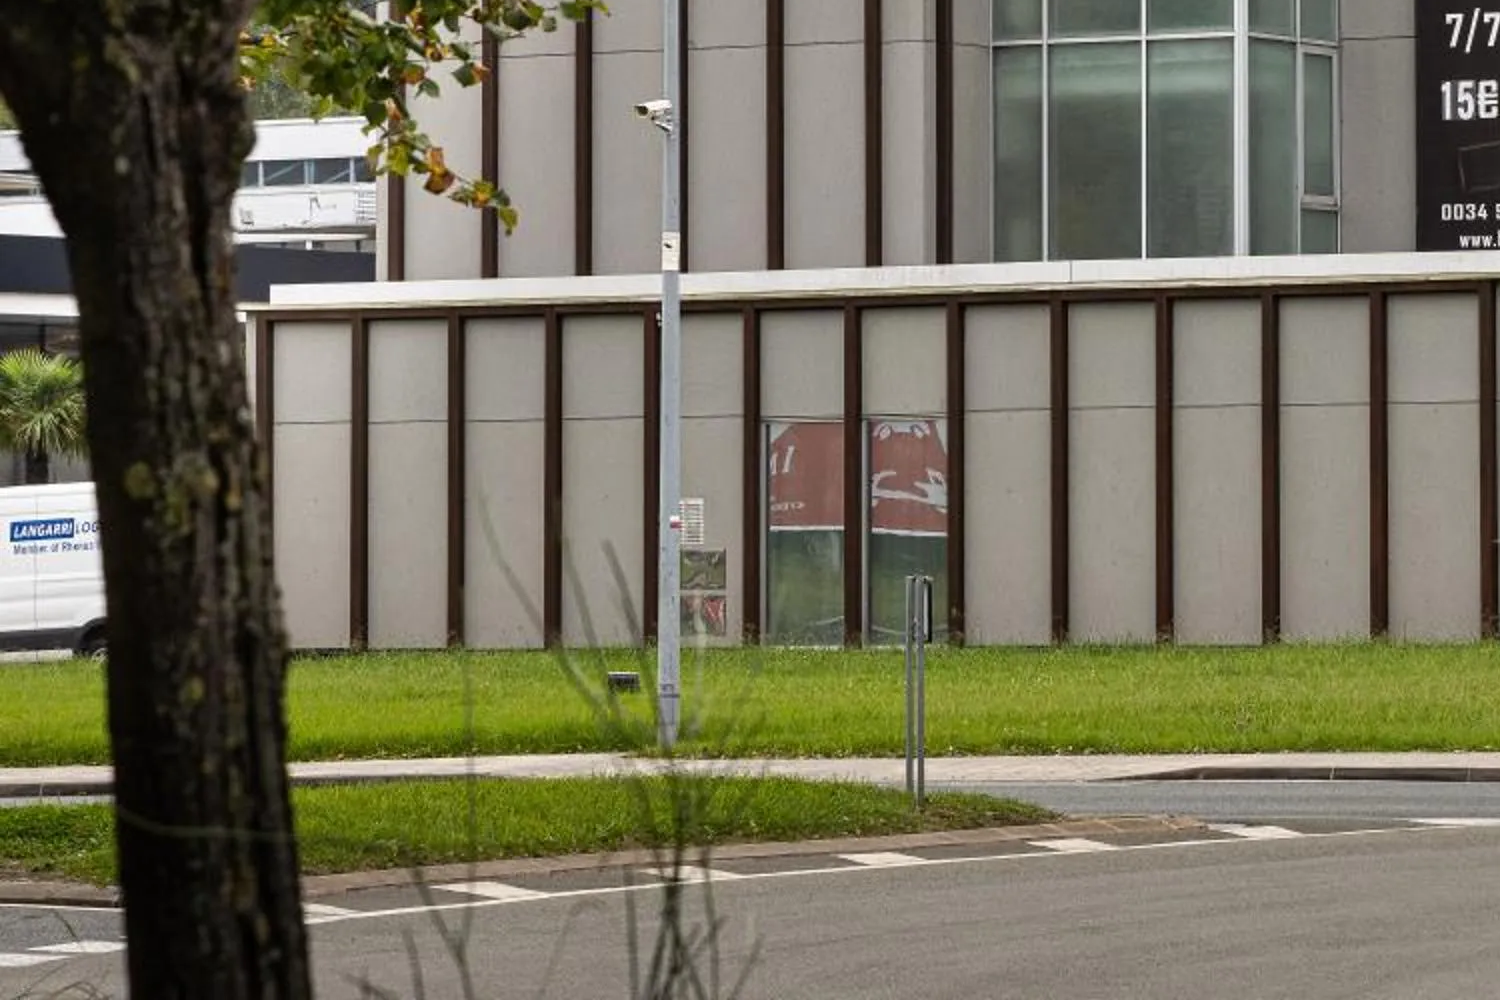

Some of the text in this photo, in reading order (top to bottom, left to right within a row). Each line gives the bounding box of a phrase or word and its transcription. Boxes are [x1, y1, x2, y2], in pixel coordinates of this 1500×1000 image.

[1441, 80, 1499, 121] 15€
[1441, 203, 1488, 221] 0034
[13, 522, 73, 539] LANGARRI
